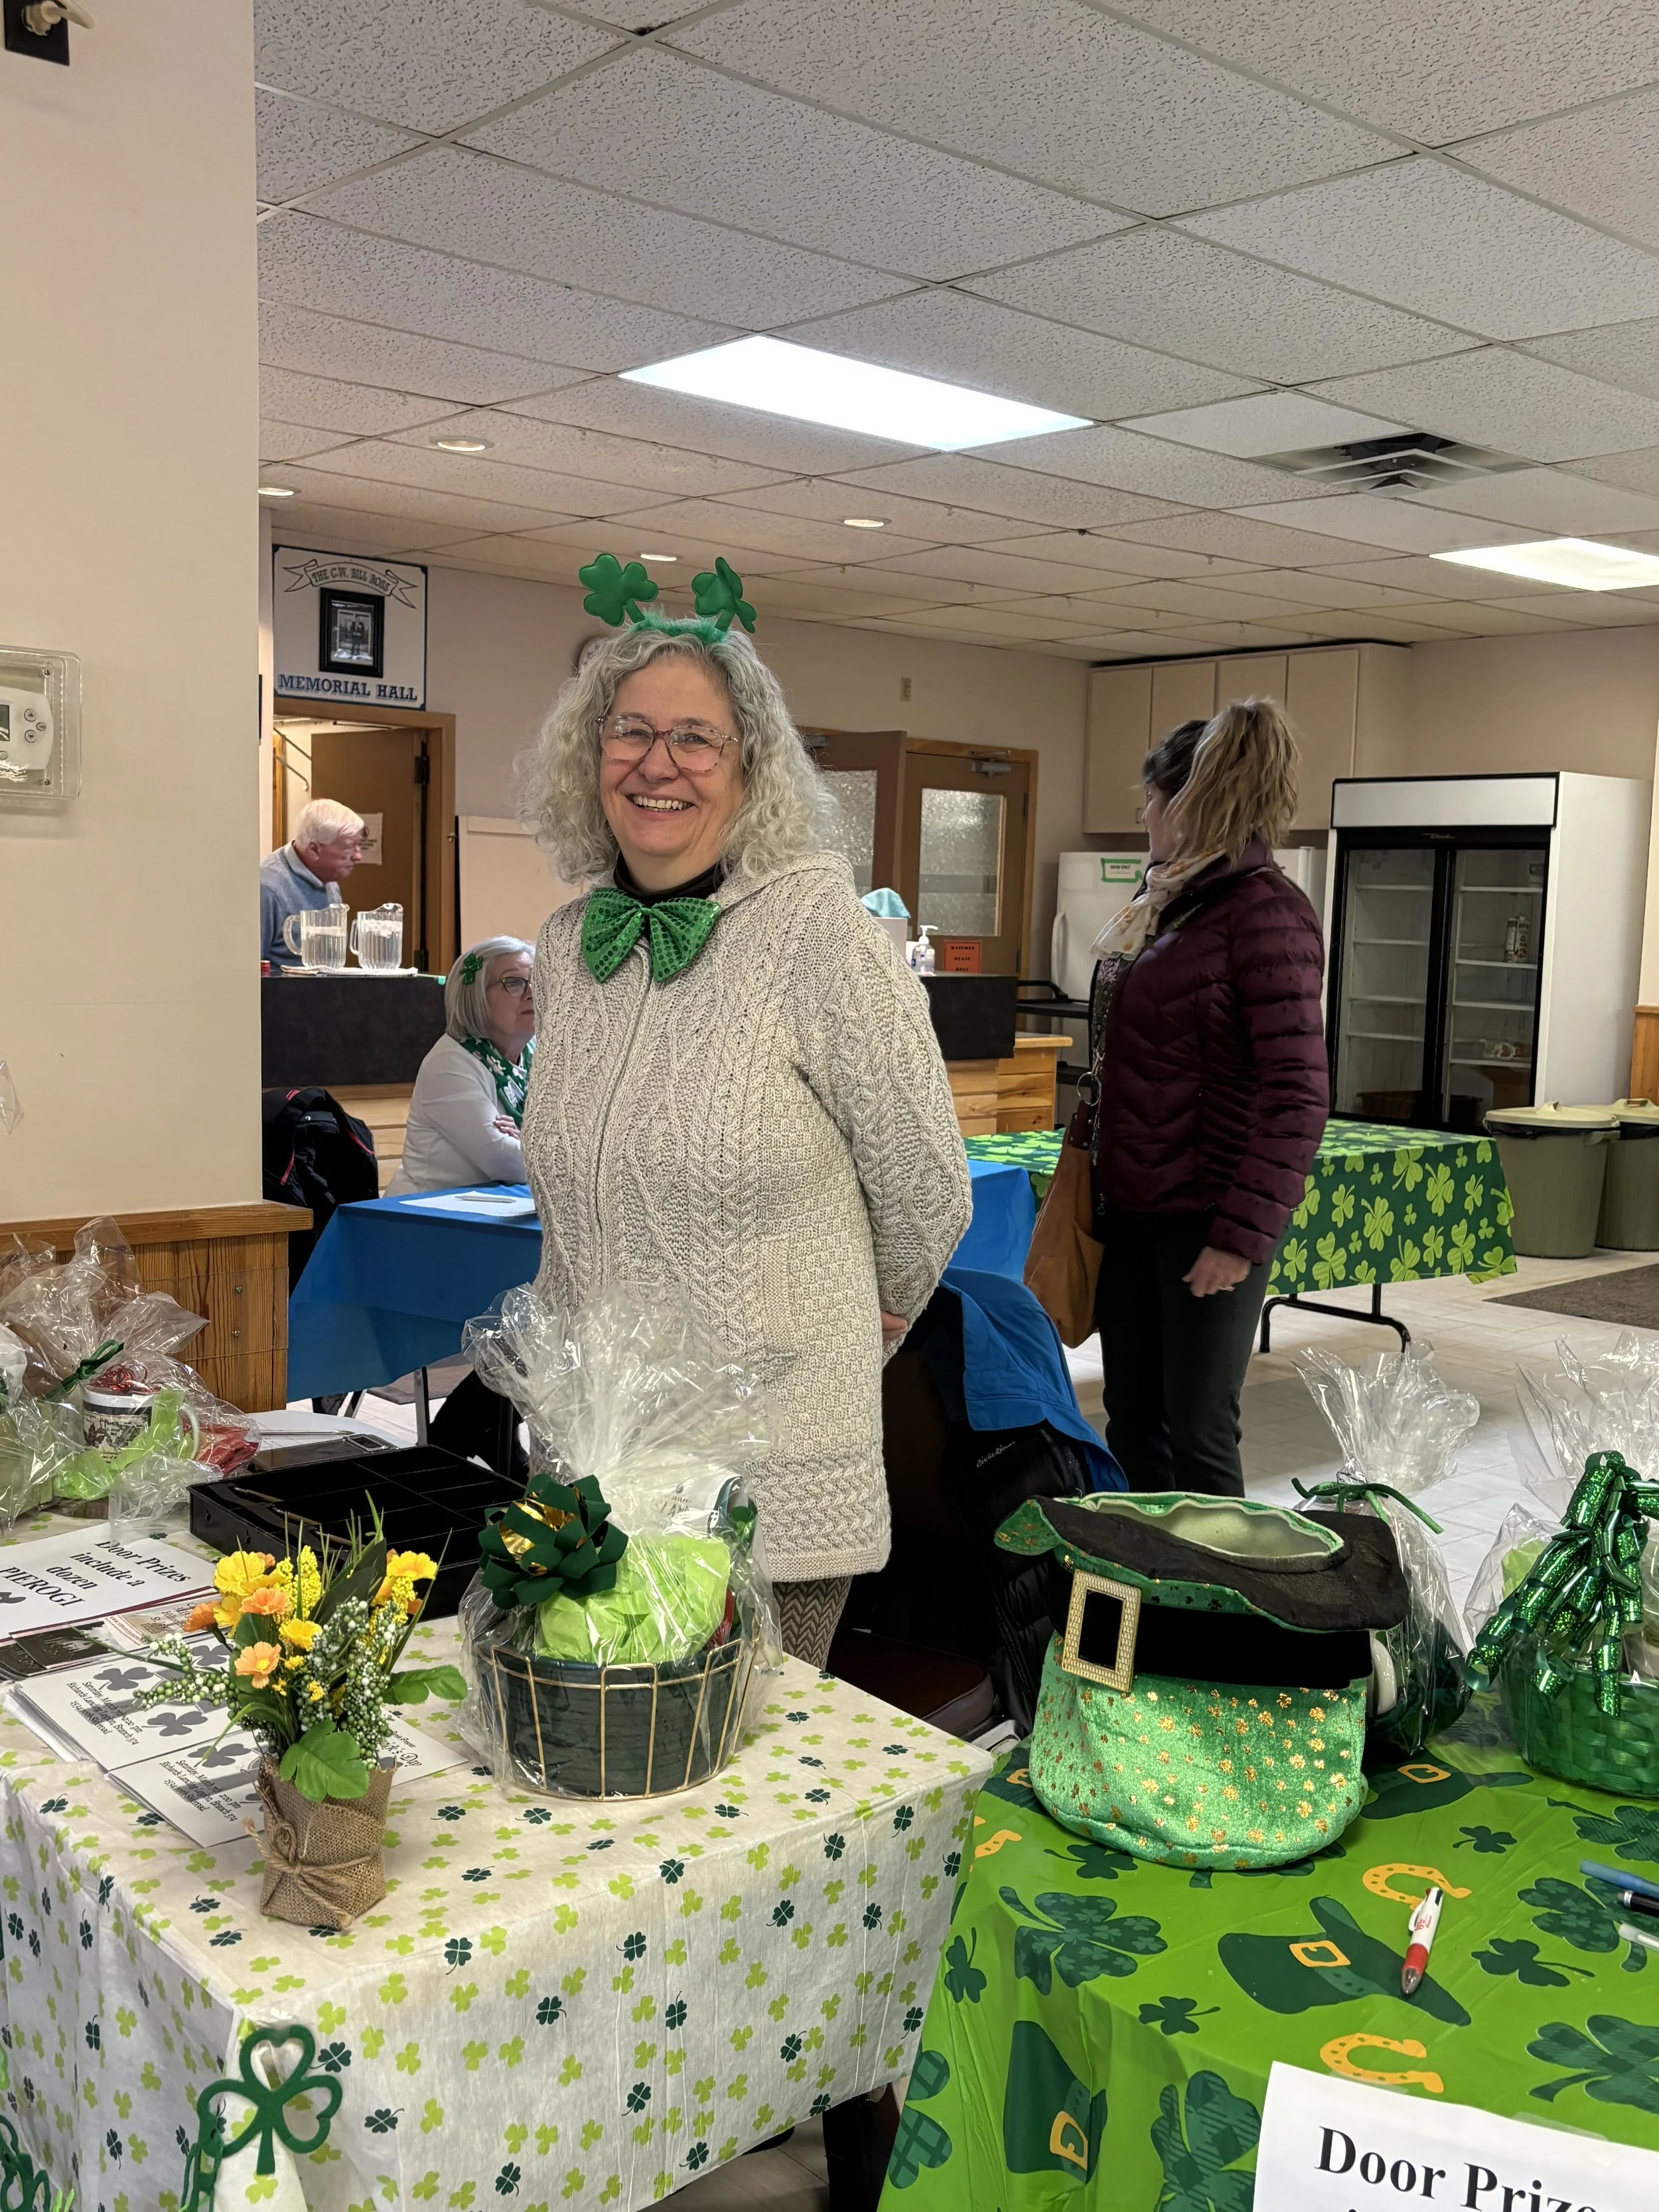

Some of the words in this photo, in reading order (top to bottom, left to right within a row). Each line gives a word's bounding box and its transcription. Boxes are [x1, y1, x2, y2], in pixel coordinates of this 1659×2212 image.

[311, 569, 329, 583] THE
[350, 568, 367, 581] BILL
[369, 574, 390, 591] ROSS
[278, 674, 370, 696] MEMORIAL
[376, 684, 417, 701] HALL
[69, 1552, 131, 1580] include
[94, 1541, 142, 1560] Door
[134, 1557, 191, 1582] Prizes
[0, 1566, 86, 1607] PIEROGI
[46, 1566, 98, 1589] dozen
[1315, 2126, 1446, 2199] Door
[1460, 2162, 1596, 2212] Pri
